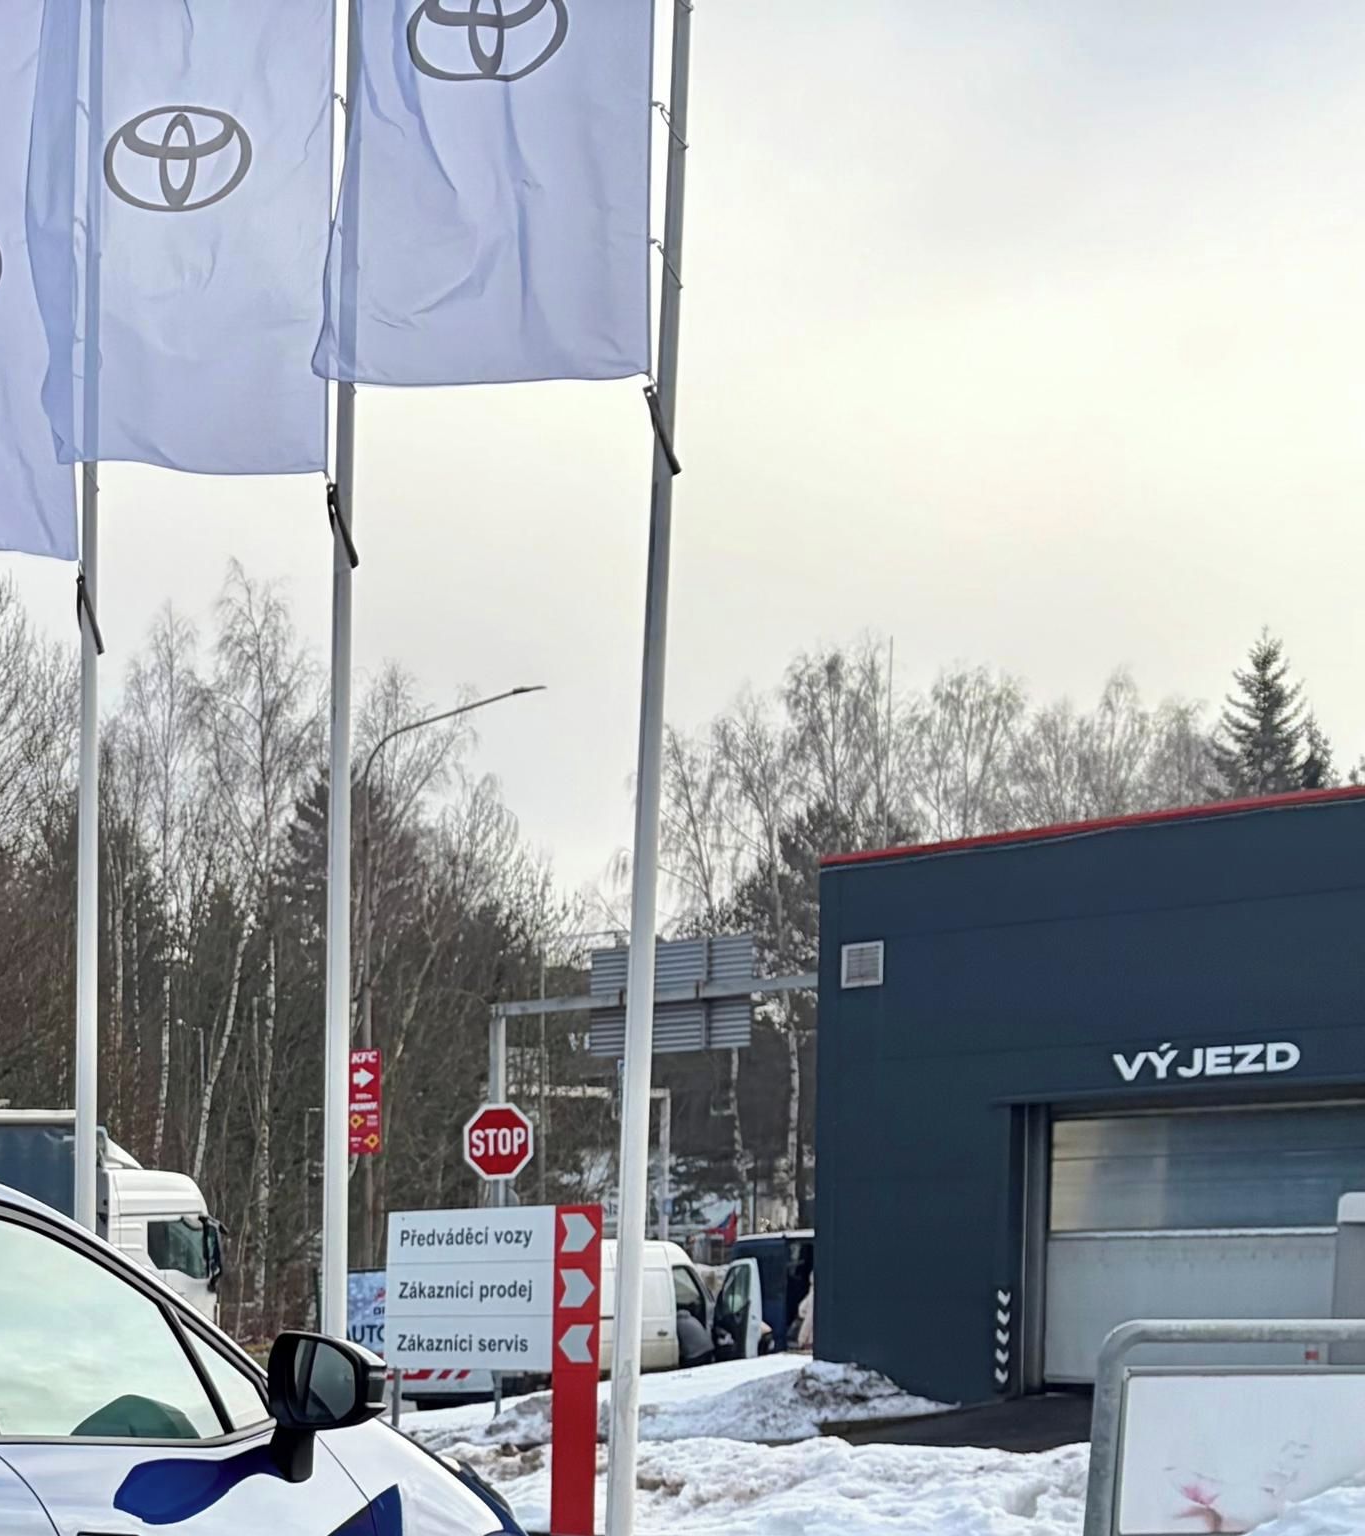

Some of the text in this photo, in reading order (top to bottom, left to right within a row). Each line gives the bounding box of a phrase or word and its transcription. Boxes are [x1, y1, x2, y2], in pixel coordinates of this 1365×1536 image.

[351, 1050, 378, 1065] KFC
[1112, 1042, 1301, 1082] VÝJEZD
[471, 1127, 526, 1157] STOP
[399, 1226, 533, 1249] Předváděcí vozy
[398, 1279, 533, 1303] Zákazníci prodej
[396, 1333, 529, 1353] Zákazníci servis
